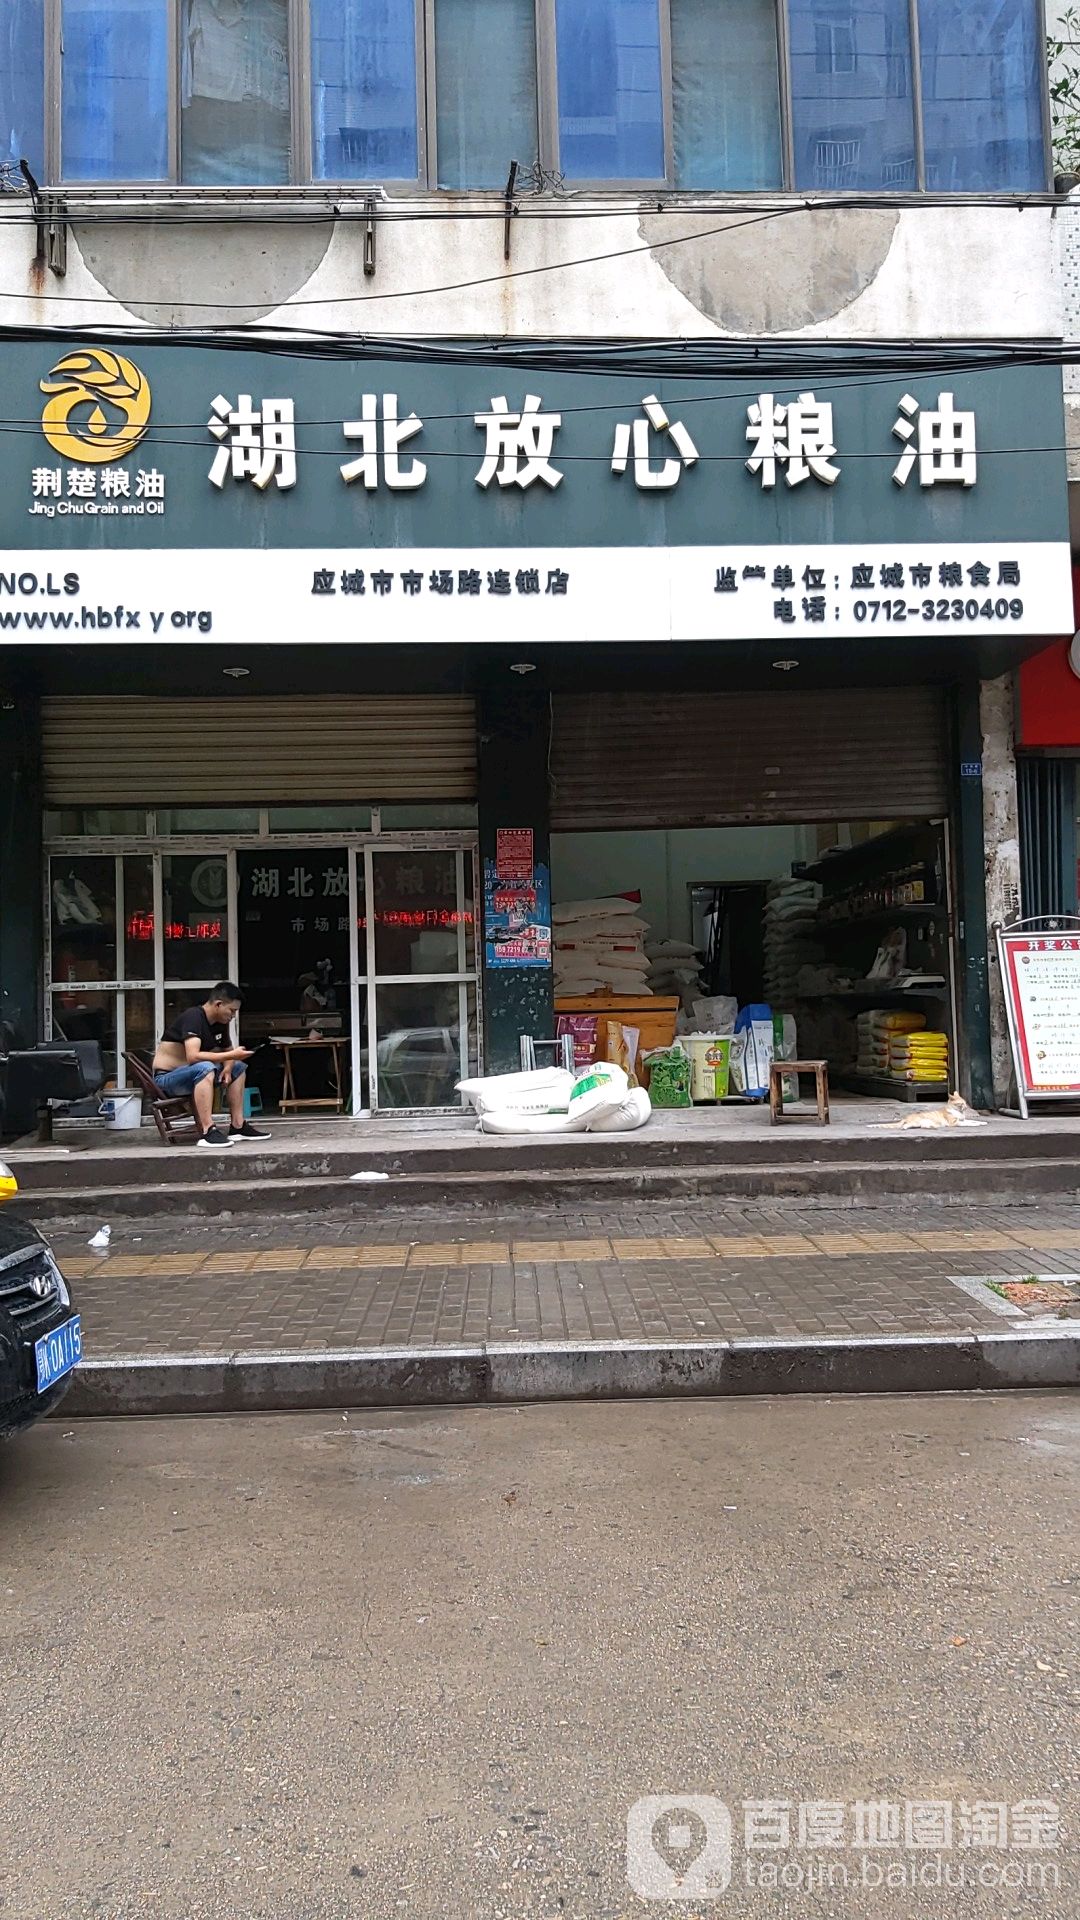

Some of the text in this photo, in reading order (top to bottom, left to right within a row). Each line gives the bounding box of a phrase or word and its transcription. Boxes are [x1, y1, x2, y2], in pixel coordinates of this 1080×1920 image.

[206, 391, 977, 490] 湖北放心粮油
[31, 467, 165, 498] 荆楚粮油
[28, 501, 55, 517] Jing
[121, 501, 144, 514] and
[146, 501, 164, 514] Oil
[0, 572, 80, 595] NO.LS
[311, 568, 570, 596] 应城市市场路连锁店
[1028, 939, 1080, 951] 开奖公
